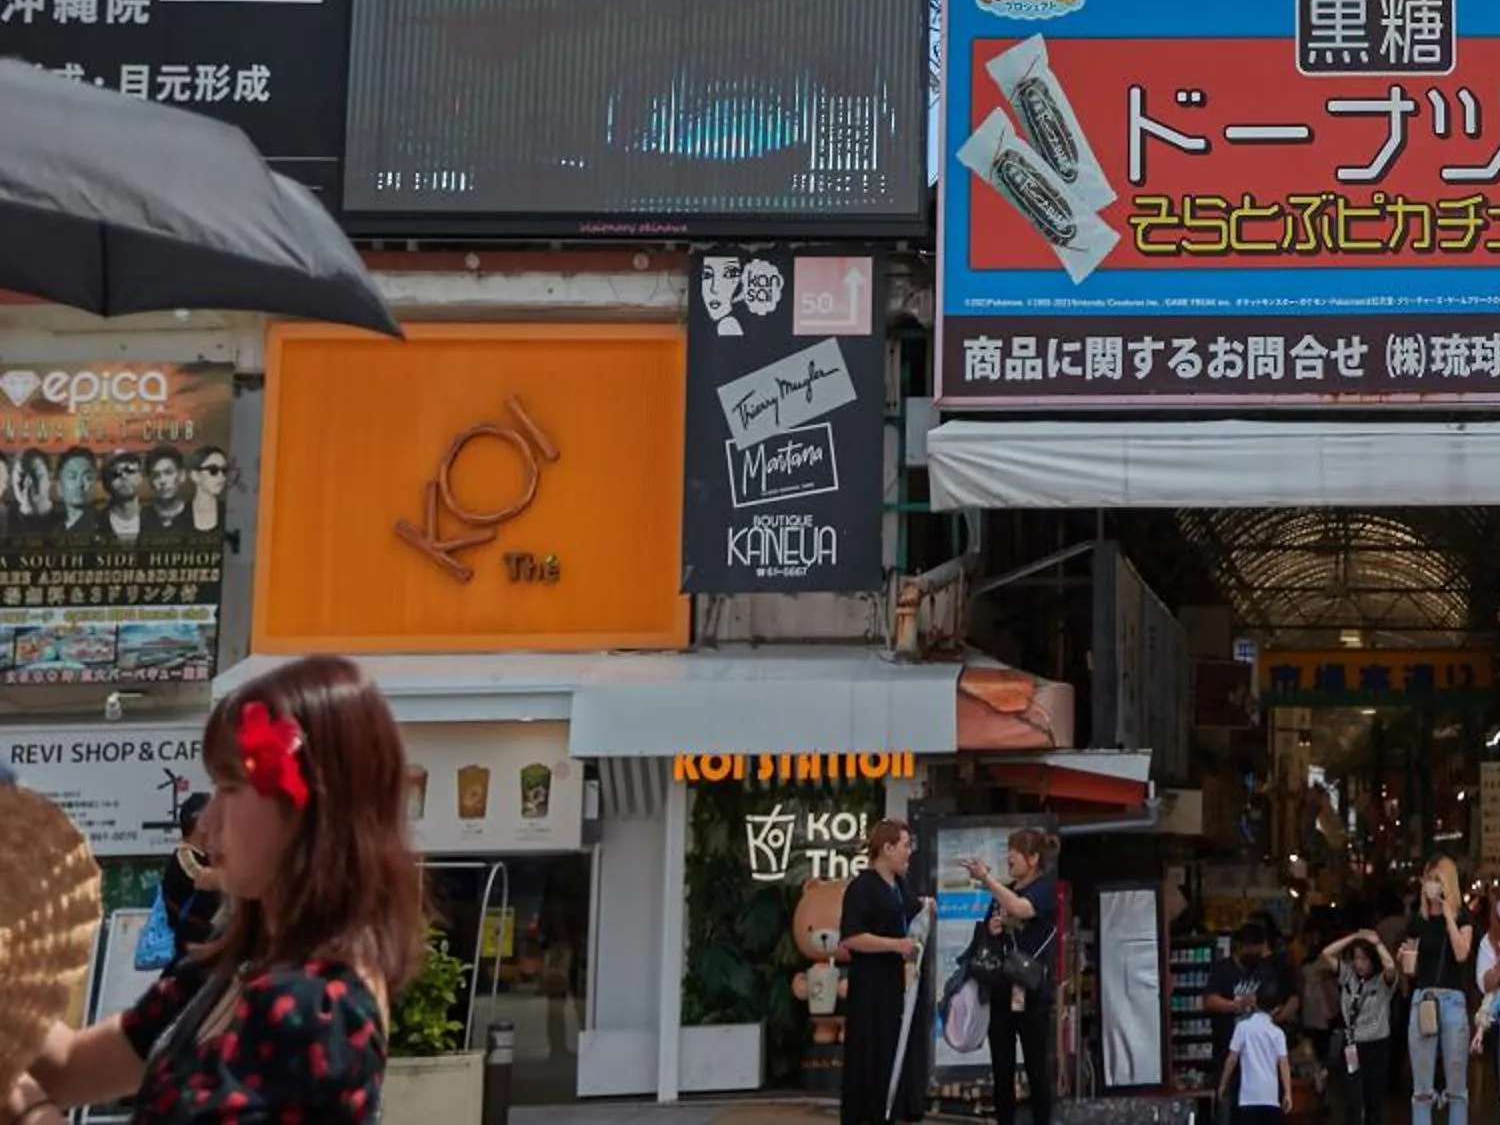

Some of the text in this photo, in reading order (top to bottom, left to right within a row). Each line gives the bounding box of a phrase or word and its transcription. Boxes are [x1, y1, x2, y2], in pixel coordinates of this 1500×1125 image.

[34, 63, 272, 103] ・目元形成
[747, 271, 781, 287] kan
[747, 286, 774, 303] sai
[801, 291, 834, 314] 50
[963, 334, 1369, 381] 商品に関するお問合せ
[42, 371, 169, 414] epica
[742, 439, 823, 498] Montana
[753, 514, 814, 528] BOUTIQUE
[727, 525, 838, 567] KANEYA
[20, 554, 85, 568] SOUTH
[97, 553, 138, 566] SIDE
[149, 552, 221, 567] HIPHOP
[11, 743, 63, 764] REVI
[805, 848, 869, 879] Thé
